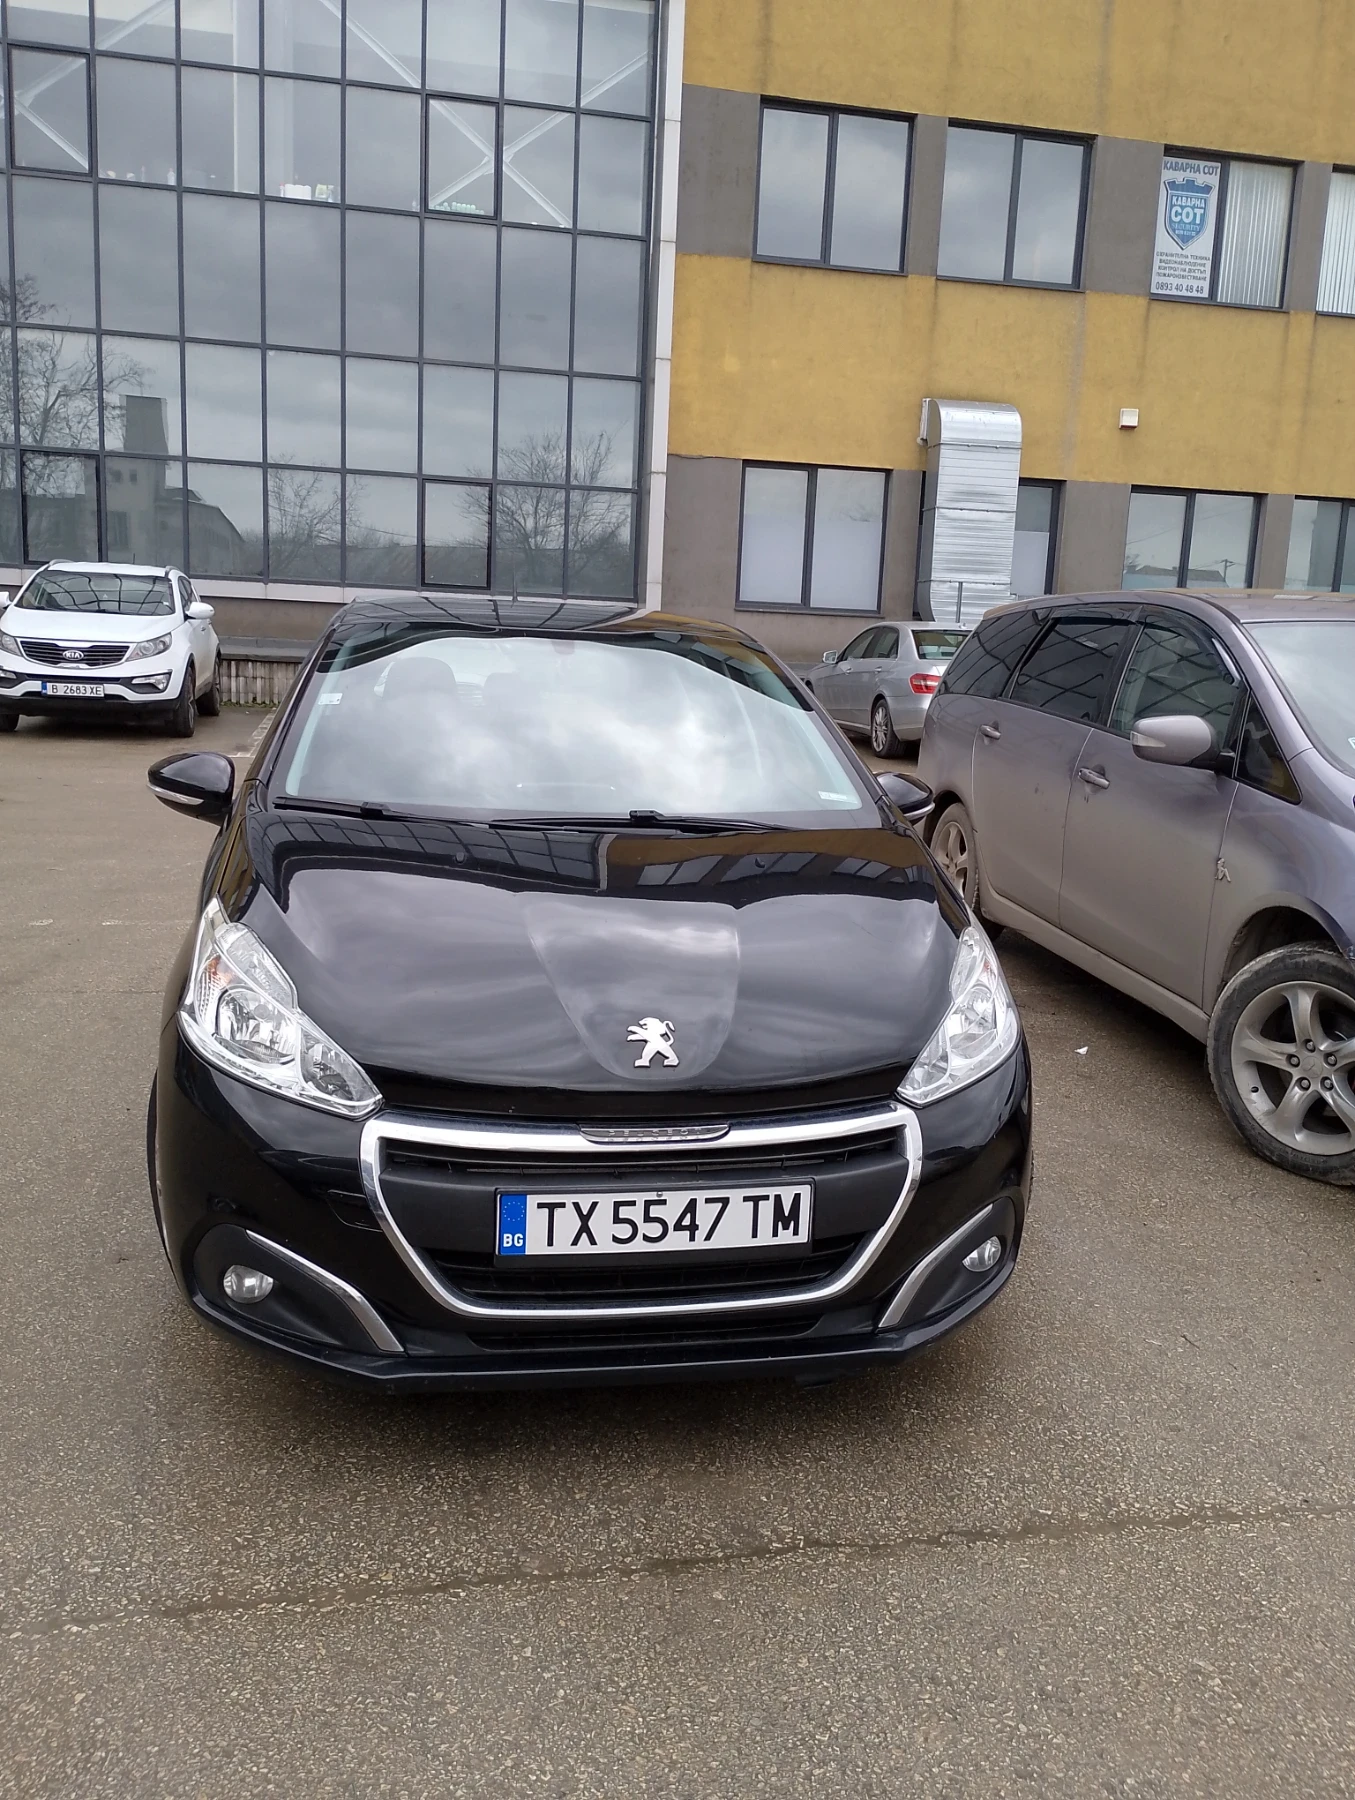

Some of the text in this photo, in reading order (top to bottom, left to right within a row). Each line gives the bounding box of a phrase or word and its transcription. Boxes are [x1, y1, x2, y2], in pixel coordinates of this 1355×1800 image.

[1163, 160, 1219, 176] КАВАРНА СОТ
[1172, 195, 1205, 208] КАВАРНА
[1171, 206, 1204, 224] СОТ
[1156, 281, 1204, 294] 0893 40 48 48
[51, 684, 58, 694] B
[63, 685, 87, 695] 2683
[89, 686, 102, 695] XE
[503, 1192, 801, 1247] BG TX 5547 TM
